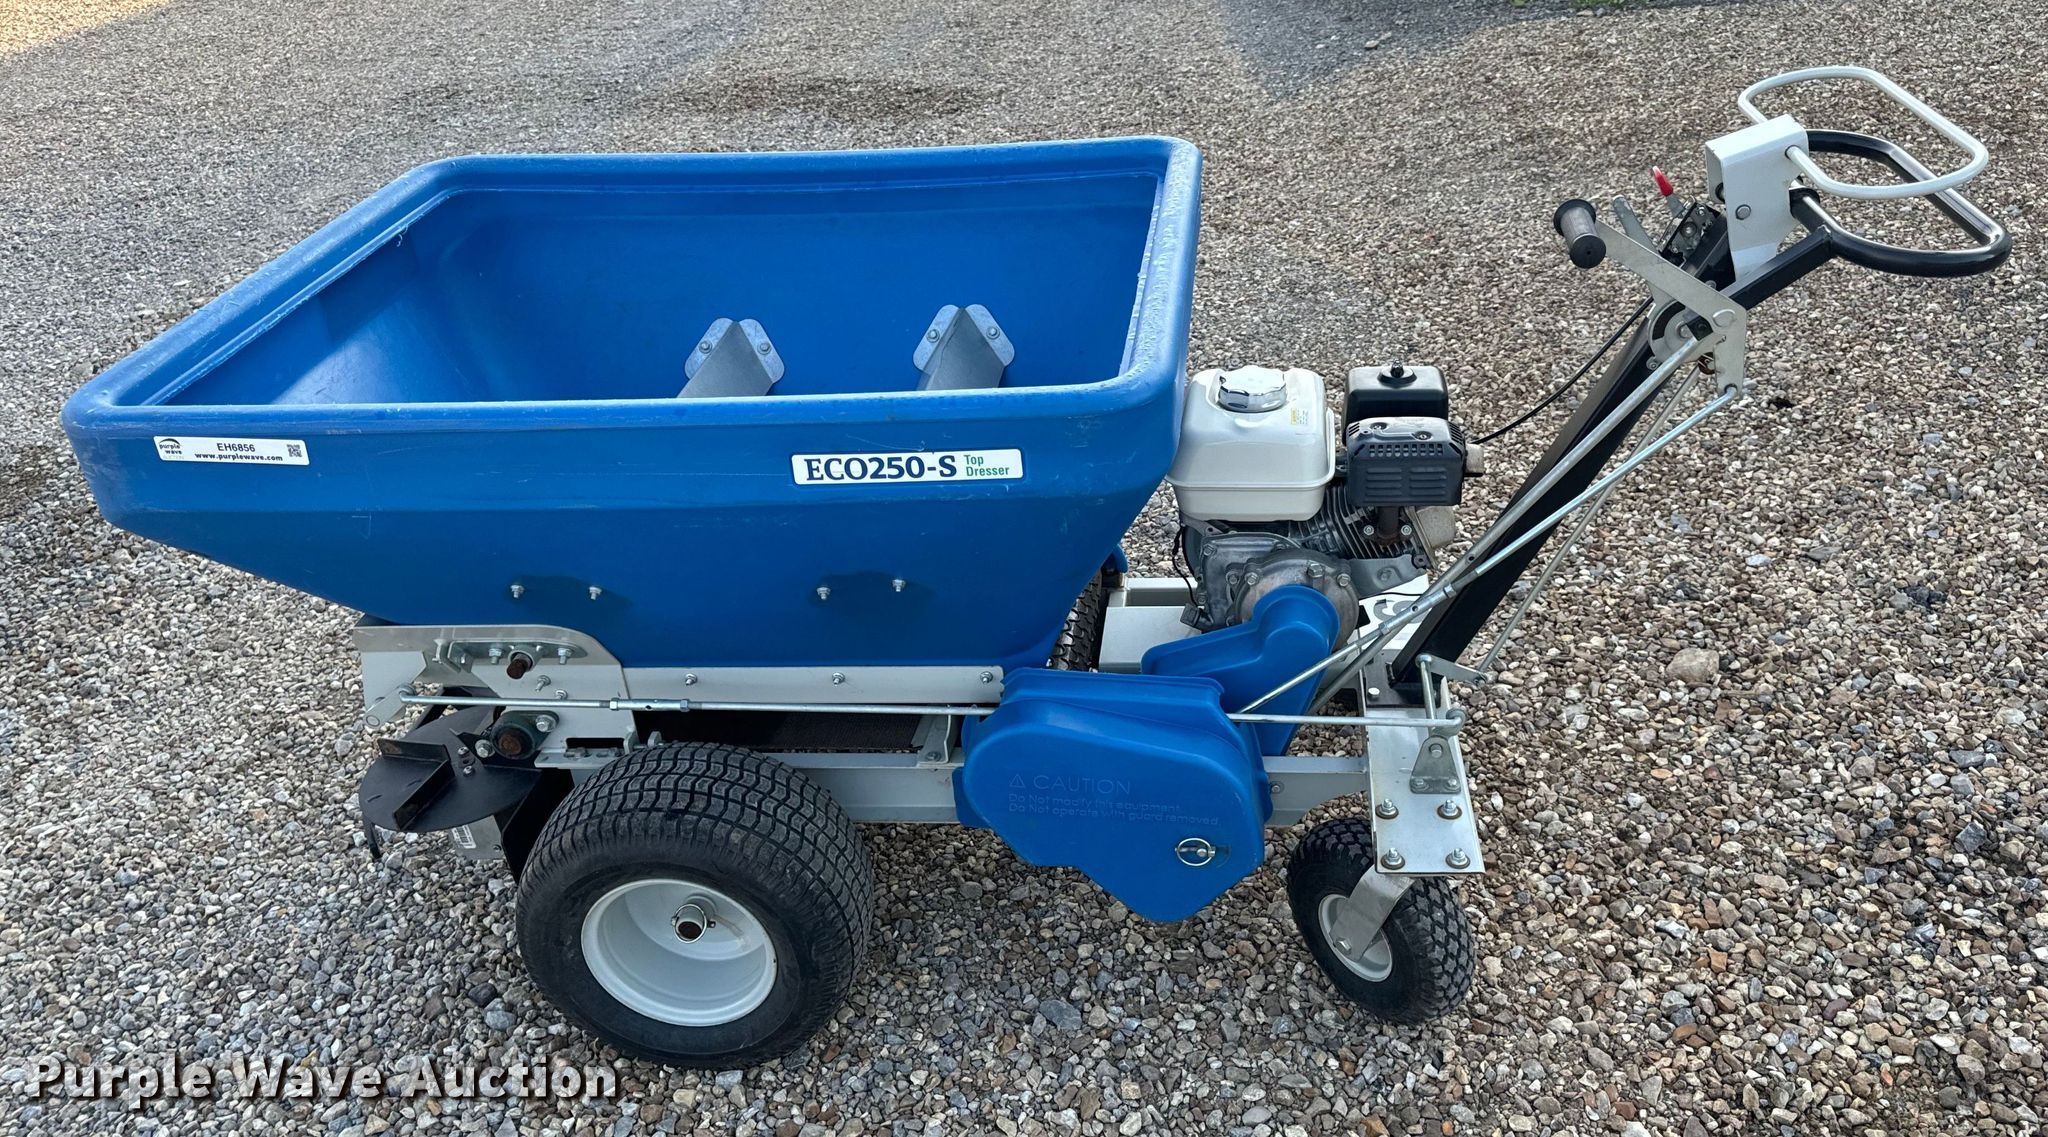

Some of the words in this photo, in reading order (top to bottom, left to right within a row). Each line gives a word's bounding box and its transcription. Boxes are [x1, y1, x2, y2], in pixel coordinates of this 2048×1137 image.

[216, 443, 256, 452] EH6856
[194, 452, 283, 461] www.purplewave.com
[963, 454, 984, 466] Top
[804, 455, 957, 480] ECO250-S
[966, 466, 1010, 477] Dresser
[1033, 775, 1130, 795] CAUTION
[1009, 793, 1025, 803] Do
[1029, 794, 1050, 805] Not
[1009, 803, 1025, 813] Do
[1029, 805, 1050, 814] Not
[1052, 807, 1099, 818] operate
[1128, 811, 1163, 822] guard
